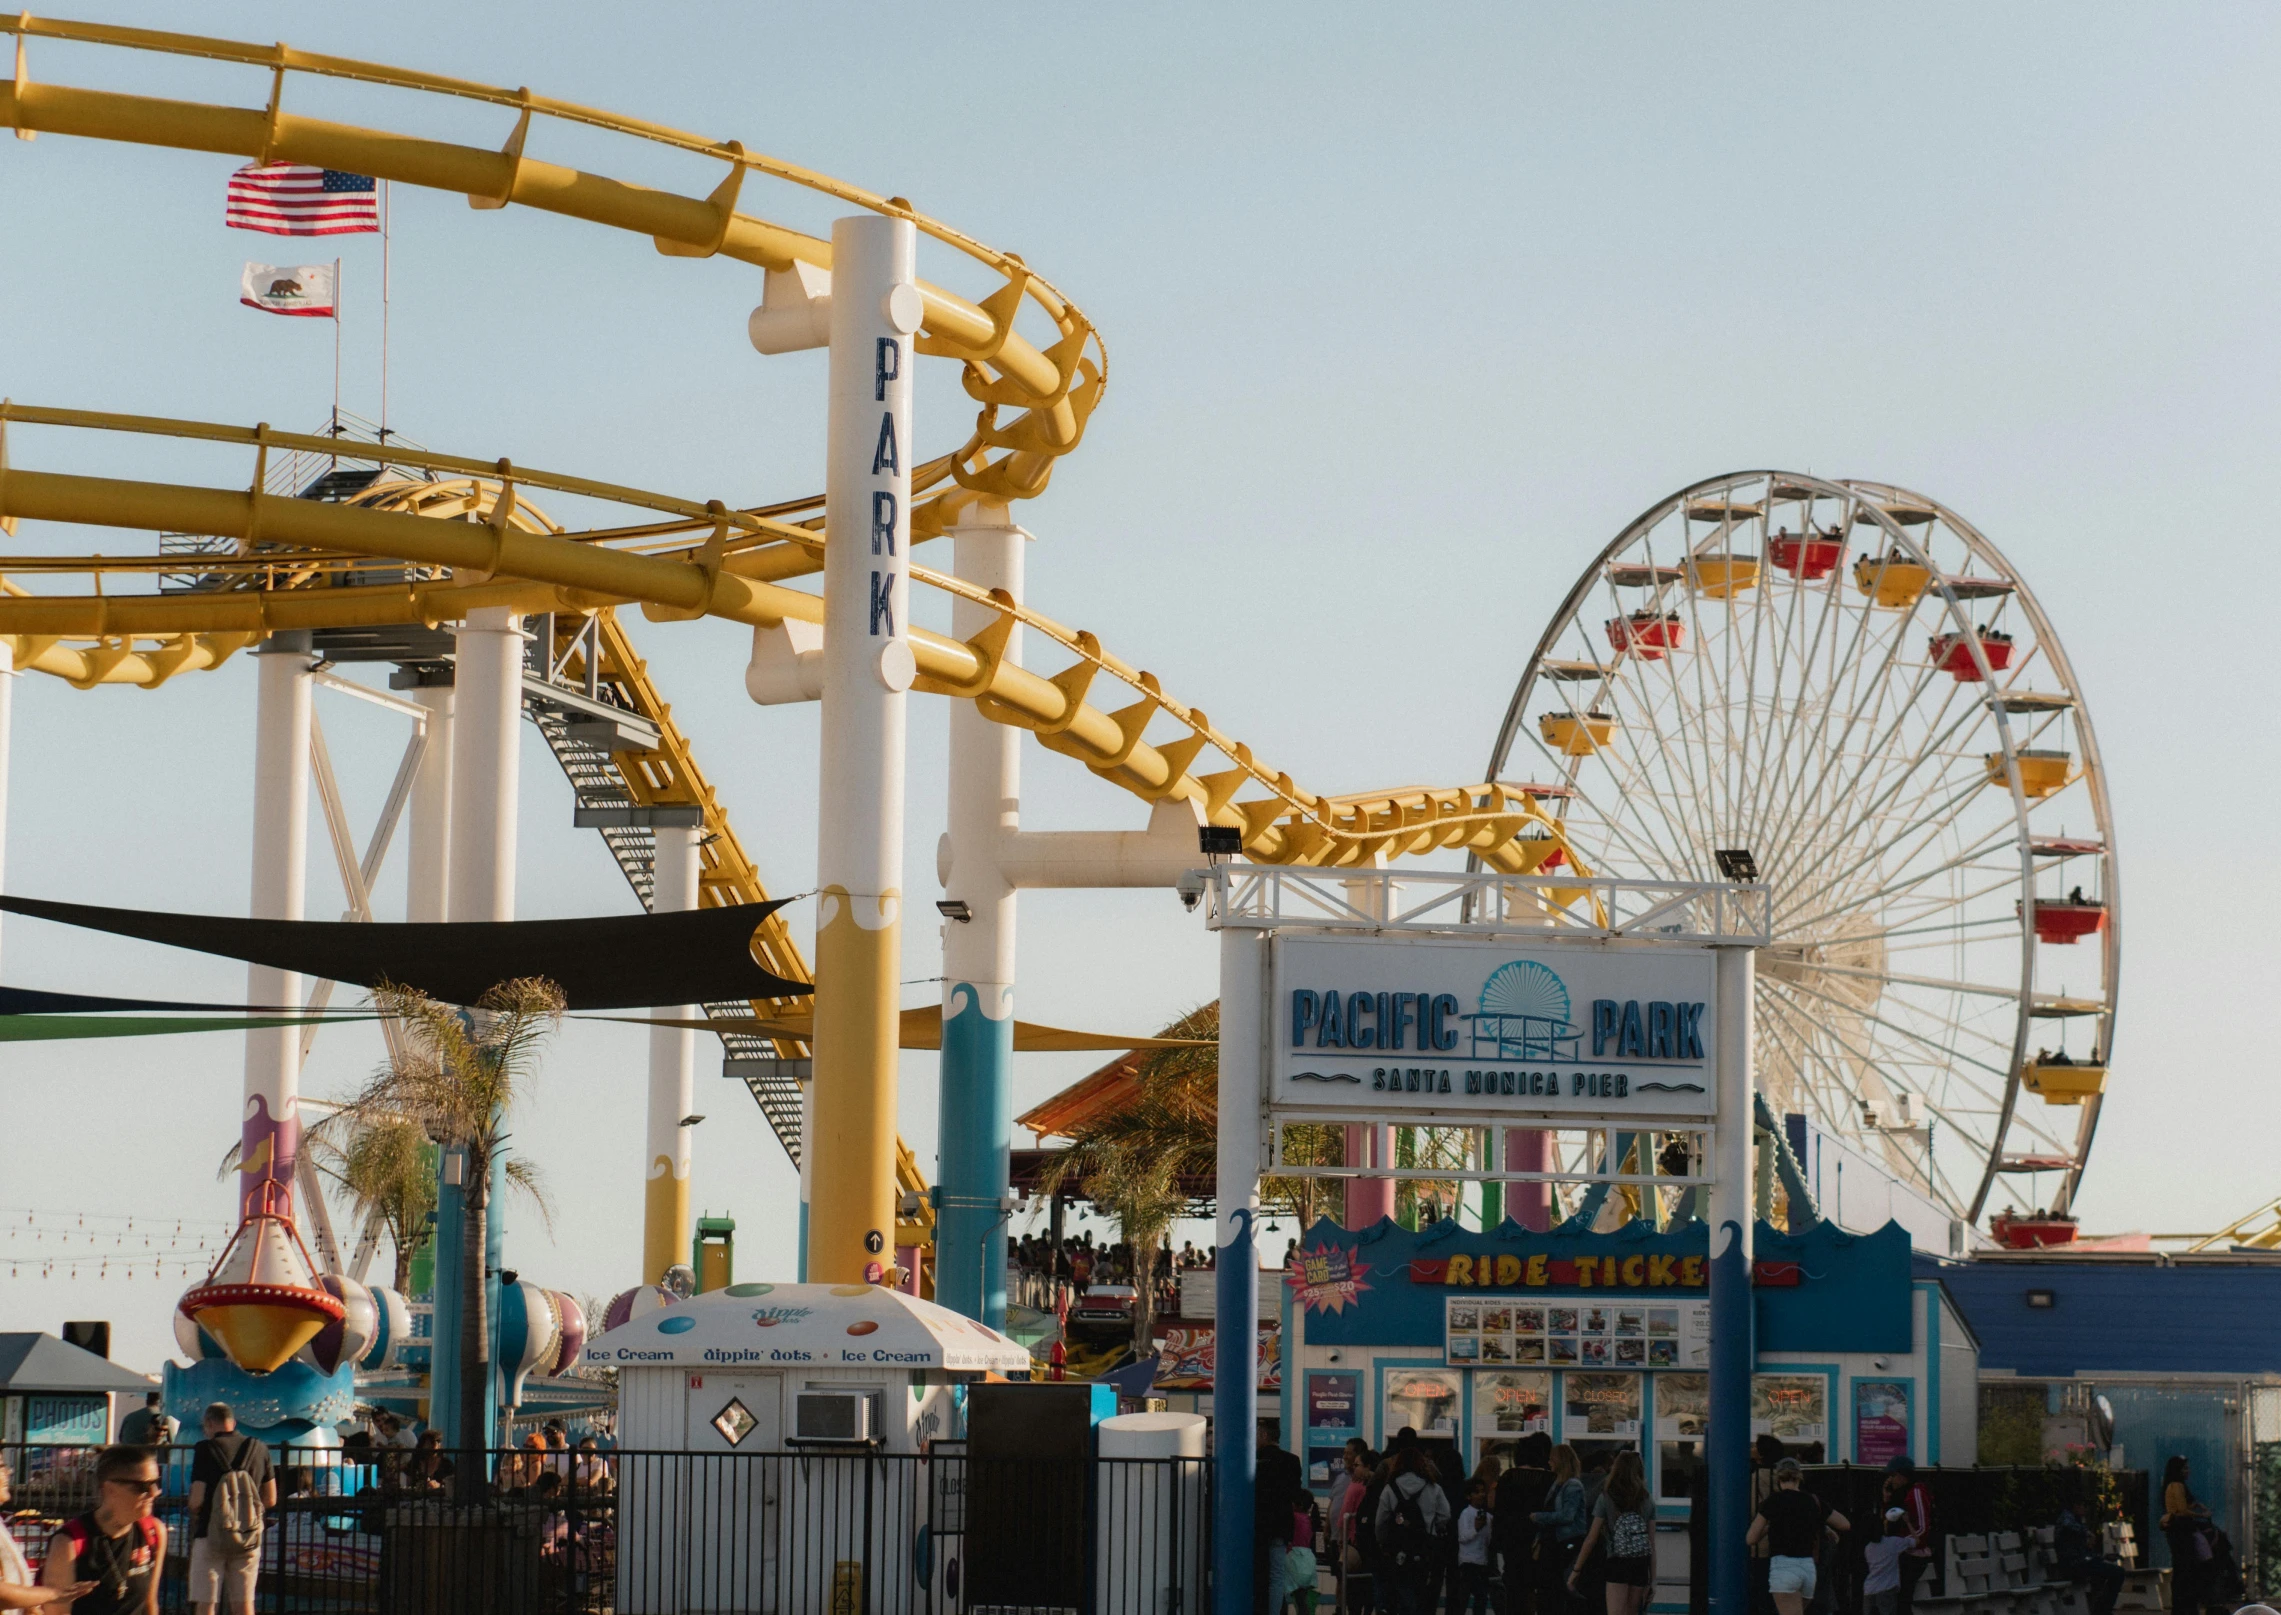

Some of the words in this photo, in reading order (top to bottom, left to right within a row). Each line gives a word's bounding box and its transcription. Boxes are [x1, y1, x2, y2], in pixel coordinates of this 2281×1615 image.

[870, 336, 901, 637] PARK
[1292, 989, 1459, 1051] PACIFIC
[1592, 1000, 1705, 1058] PARK
[1372, 1068, 1452, 1094] SANTA
[1465, 1070, 1560, 1098] MONICA
[1574, 1073, 1629, 1098] PIER
[1305, 1256, 1328, 1271] GAME
[1445, 1253, 1549, 1287] RIDE
[1574, 1254, 1756, 1288] TICKE
[1307, 1269, 1329, 1285] CARD
[1303, 1288, 1320, 1297] $25
[1334, 1280, 1355, 1292] $20
[587, 1349, 611, 1361] Ice
[617, 1348, 674, 1361] Cream
[703, 1349, 764, 1363] dippin'
[770, 1349, 812, 1361] dots
[842, 1350, 866, 1361] Ice
[872, 1349, 931, 1362] Cream
[1404, 1383, 1446, 1397] OPEN
[1494, 1388, 1536, 1402] OPEN
[1583, 1390, 1628, 1403] CLOSED
[1768, 1389, 1811, 1404] OPEN
[33, 1400, 103, 1430] PHOTOS
[1539, 1419, 1545, 1430] 8
[1629, 1421, 1635, 1431] 9
[1814, 1425, 1821, 1435] 11
[939, 1477, 967, 1496] CLOSE
